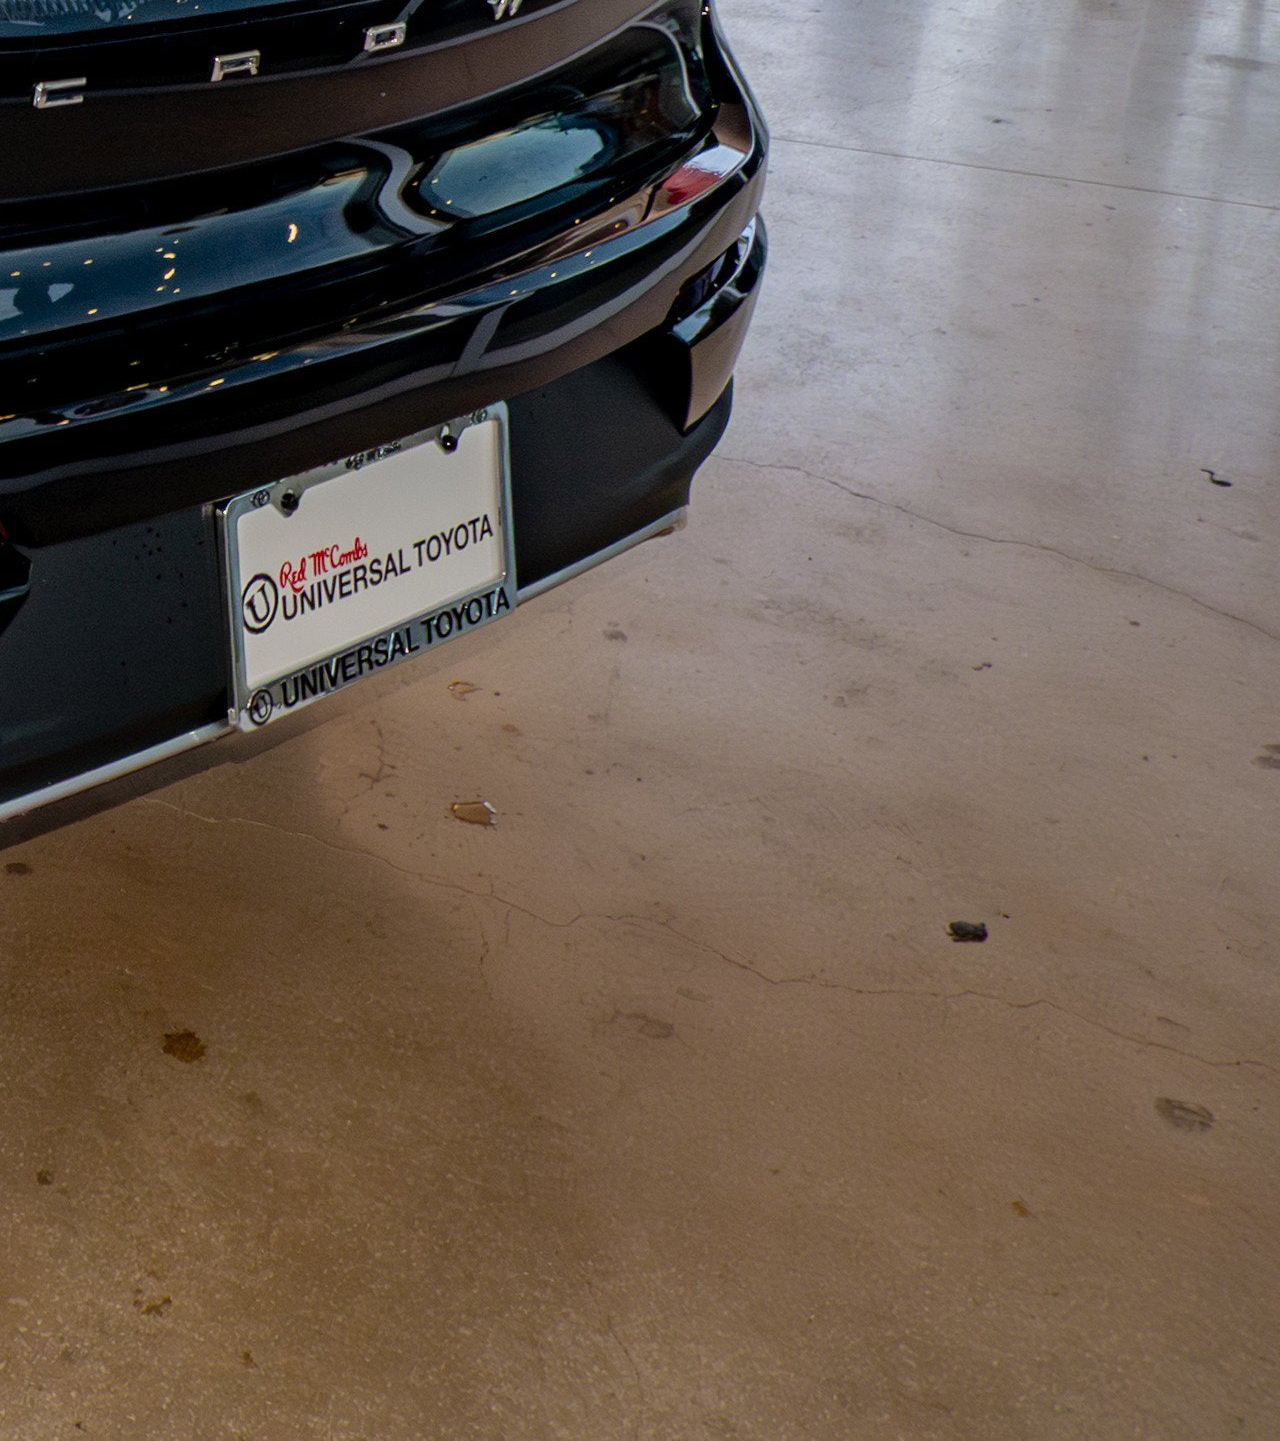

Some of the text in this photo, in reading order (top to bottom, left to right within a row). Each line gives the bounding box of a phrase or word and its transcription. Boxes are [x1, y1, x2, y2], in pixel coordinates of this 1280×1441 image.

[279, 537, 369, 594] Red McCombs
[281, 549, 411, 621] UNIVERSAL
[413, 515, 493, 567] TOYOTA
[280, 627, 420, 708] UNIVERSAL
[420, 587, 511, 645] TOYOTA
